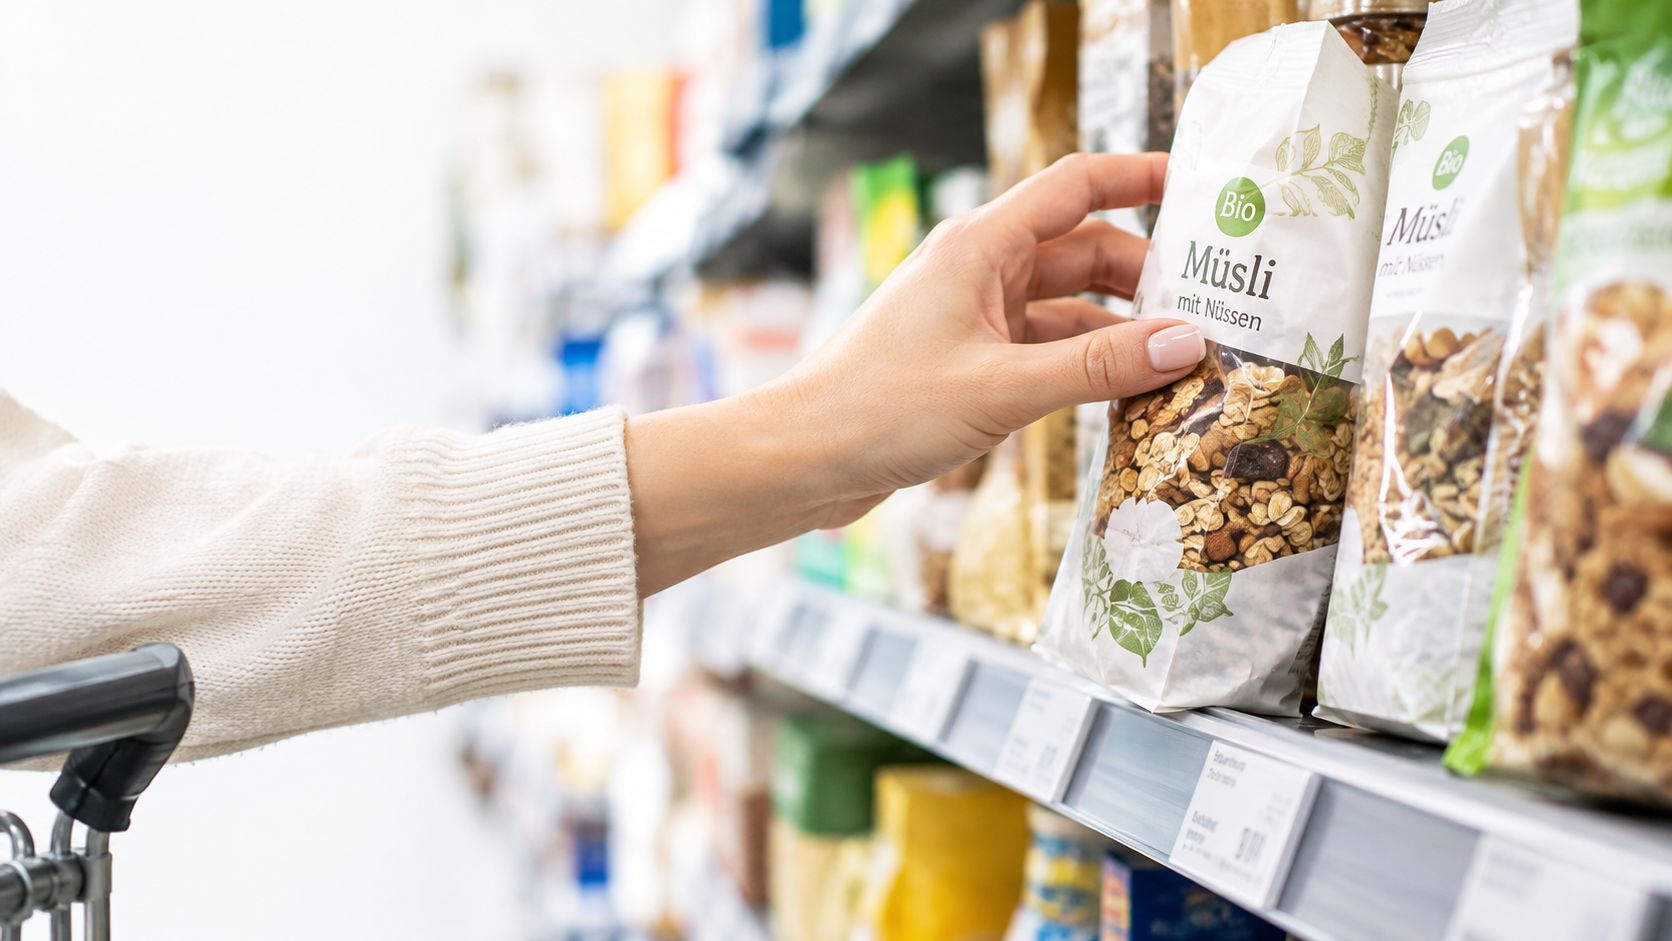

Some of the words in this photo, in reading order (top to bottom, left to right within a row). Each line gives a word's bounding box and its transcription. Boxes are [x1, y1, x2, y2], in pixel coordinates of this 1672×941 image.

[1435, 149, 1464, 177] Bio
[1219, 190, 1257, 222] Bio
[1180, 240, 1277, 300] Müsli
[1177, 293, 1201, 316] mit
[1204, 297, 1262, 332] Nüssen
